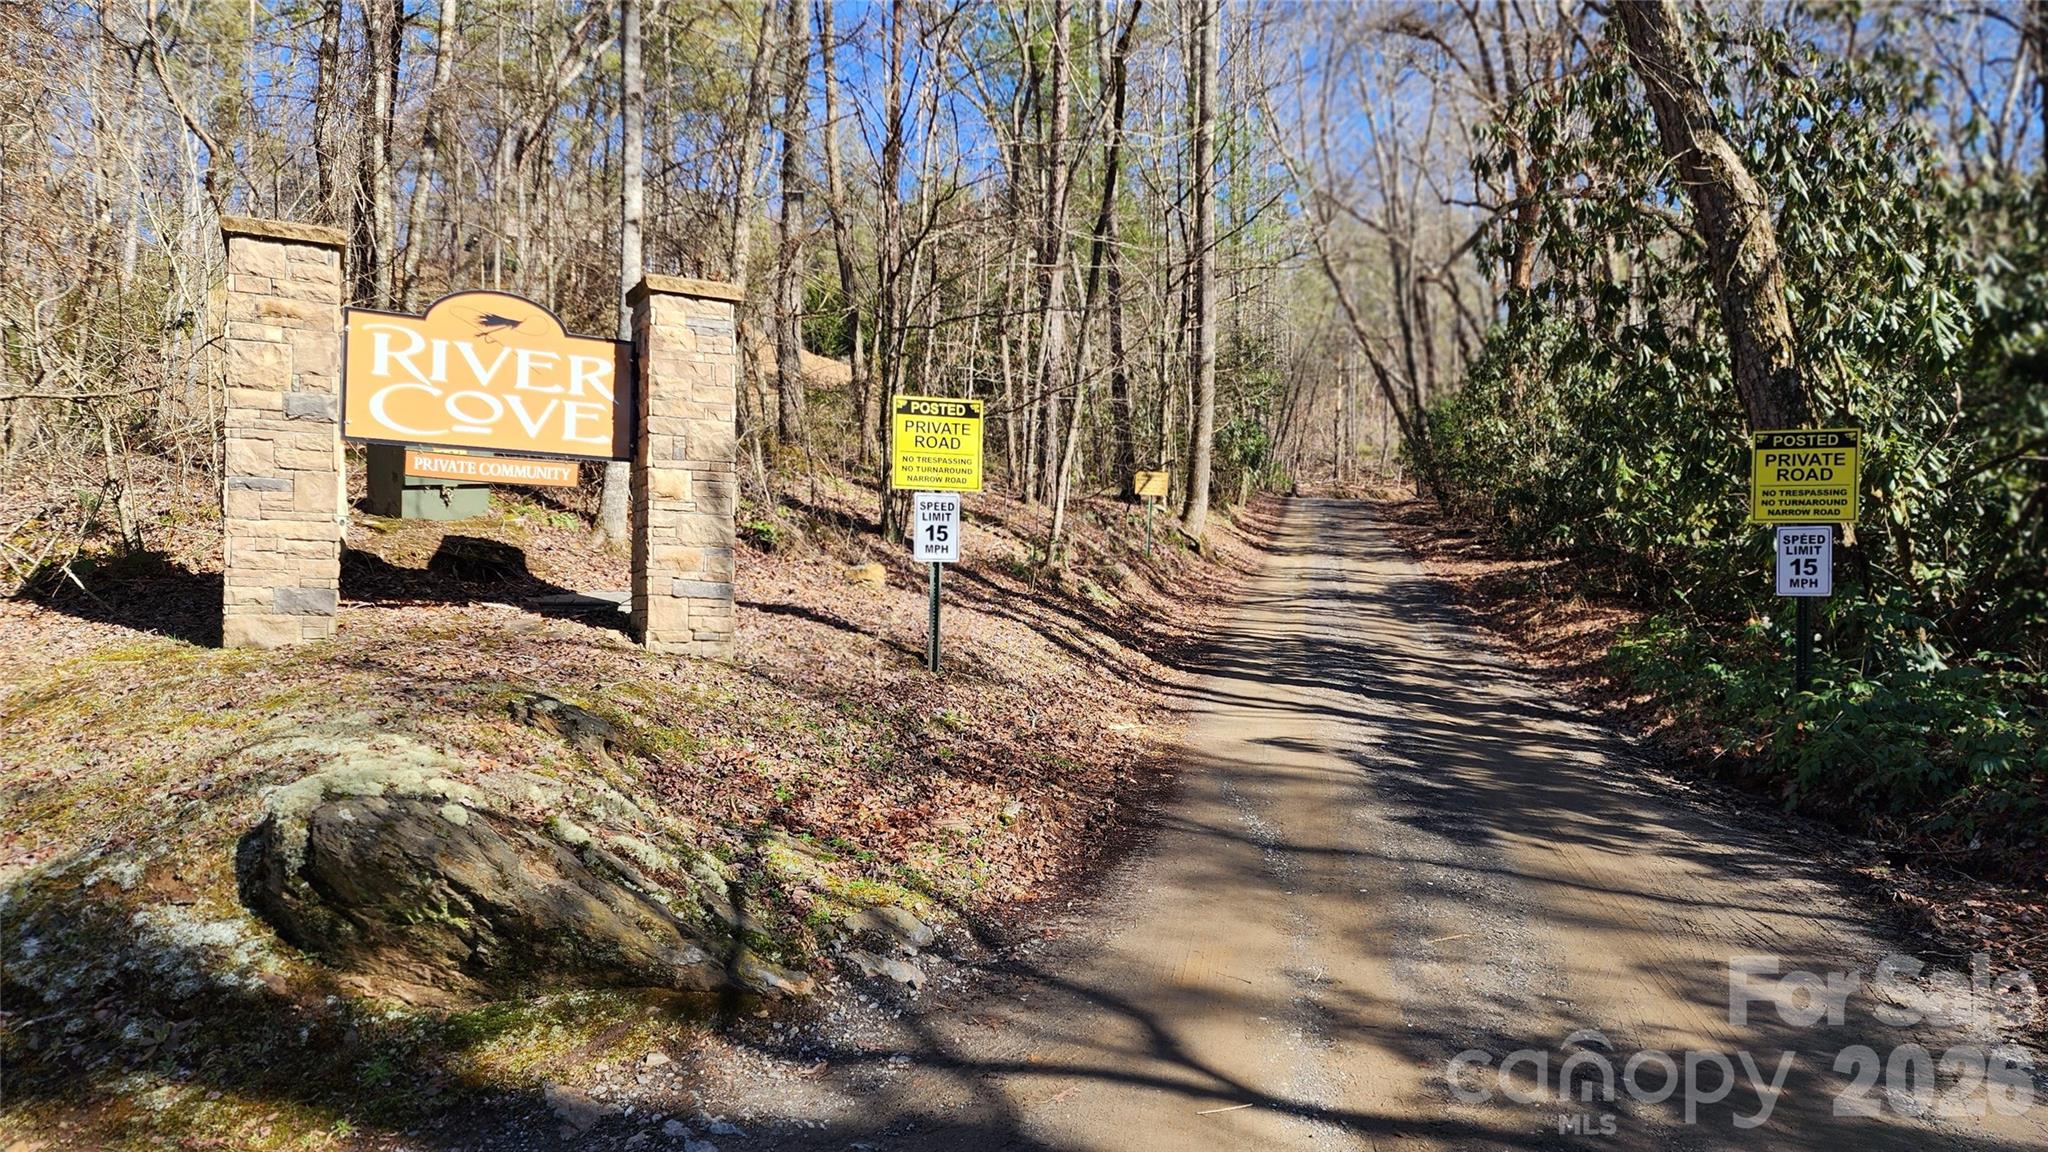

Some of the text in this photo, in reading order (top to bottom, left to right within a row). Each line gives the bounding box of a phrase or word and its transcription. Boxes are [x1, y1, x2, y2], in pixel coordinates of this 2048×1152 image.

[361, 323, 618, 402] RIVER
[368, 383, 611, 444] COVE
[910, 402, 966, 416] POSTED
[904, 420, 971, 436] PRIVATE
[914, 435, 961, 450] ROAD
[1773, 434, 1839, 447] POSTED
[917, 456, 973, 466] TRESPASSING
[1765, 452, 1846, 467] PRIVATE
[414, 457, 571, 481] PRIVATE COMMUNITY
[901, 465, 973, 475] NO TURNAROUND
[1776, 467, 1834, 482] ROAD
[906, 475, 967, 485] NARROW ROAD
[1779, 488, 1847, 497] TRESPASSING
[919, 501, 955, 512] SPEED
[922, 512, 952, 522] LIMIT
[925, 525, 949, 542] 15
[1783, 534, 1826, 545] SPEED
[925, 544, 949, 554] MPH
[1786, 546, 1822, 556] LIMIT
[1789, 558, 1818, 576] 15
[1789, 578, 1819, 588] MPH
